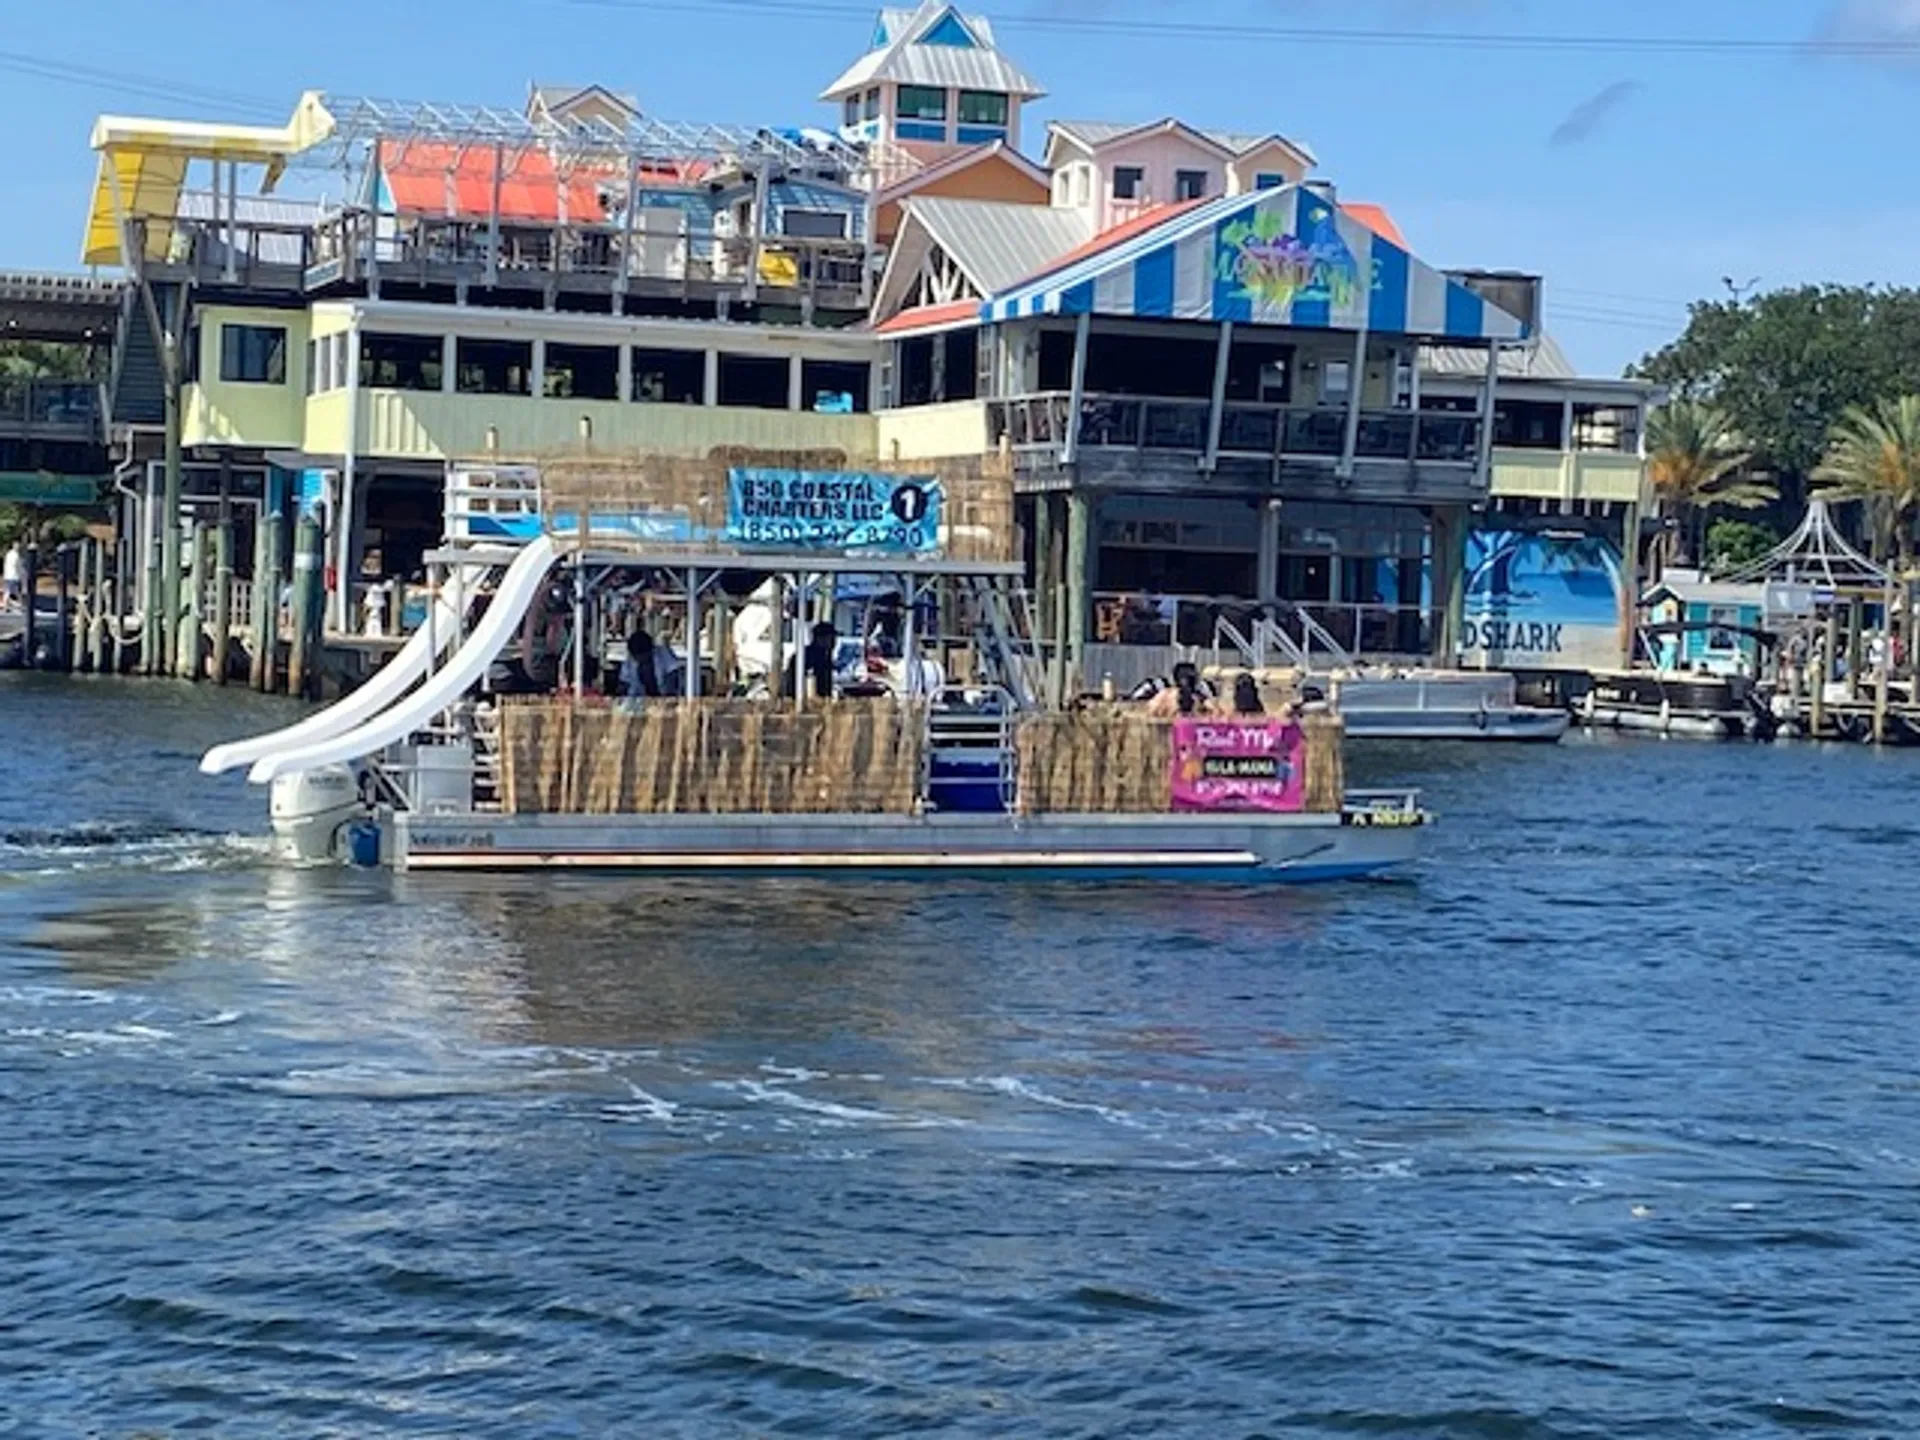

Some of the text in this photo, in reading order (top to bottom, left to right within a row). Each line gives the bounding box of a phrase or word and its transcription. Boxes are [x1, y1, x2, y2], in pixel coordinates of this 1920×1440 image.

[743, 479, 875, 502] 850 COASTAL
[743, 498, 884, 521] CHARTERS LLC
[899, 488, 917, 520] 1
